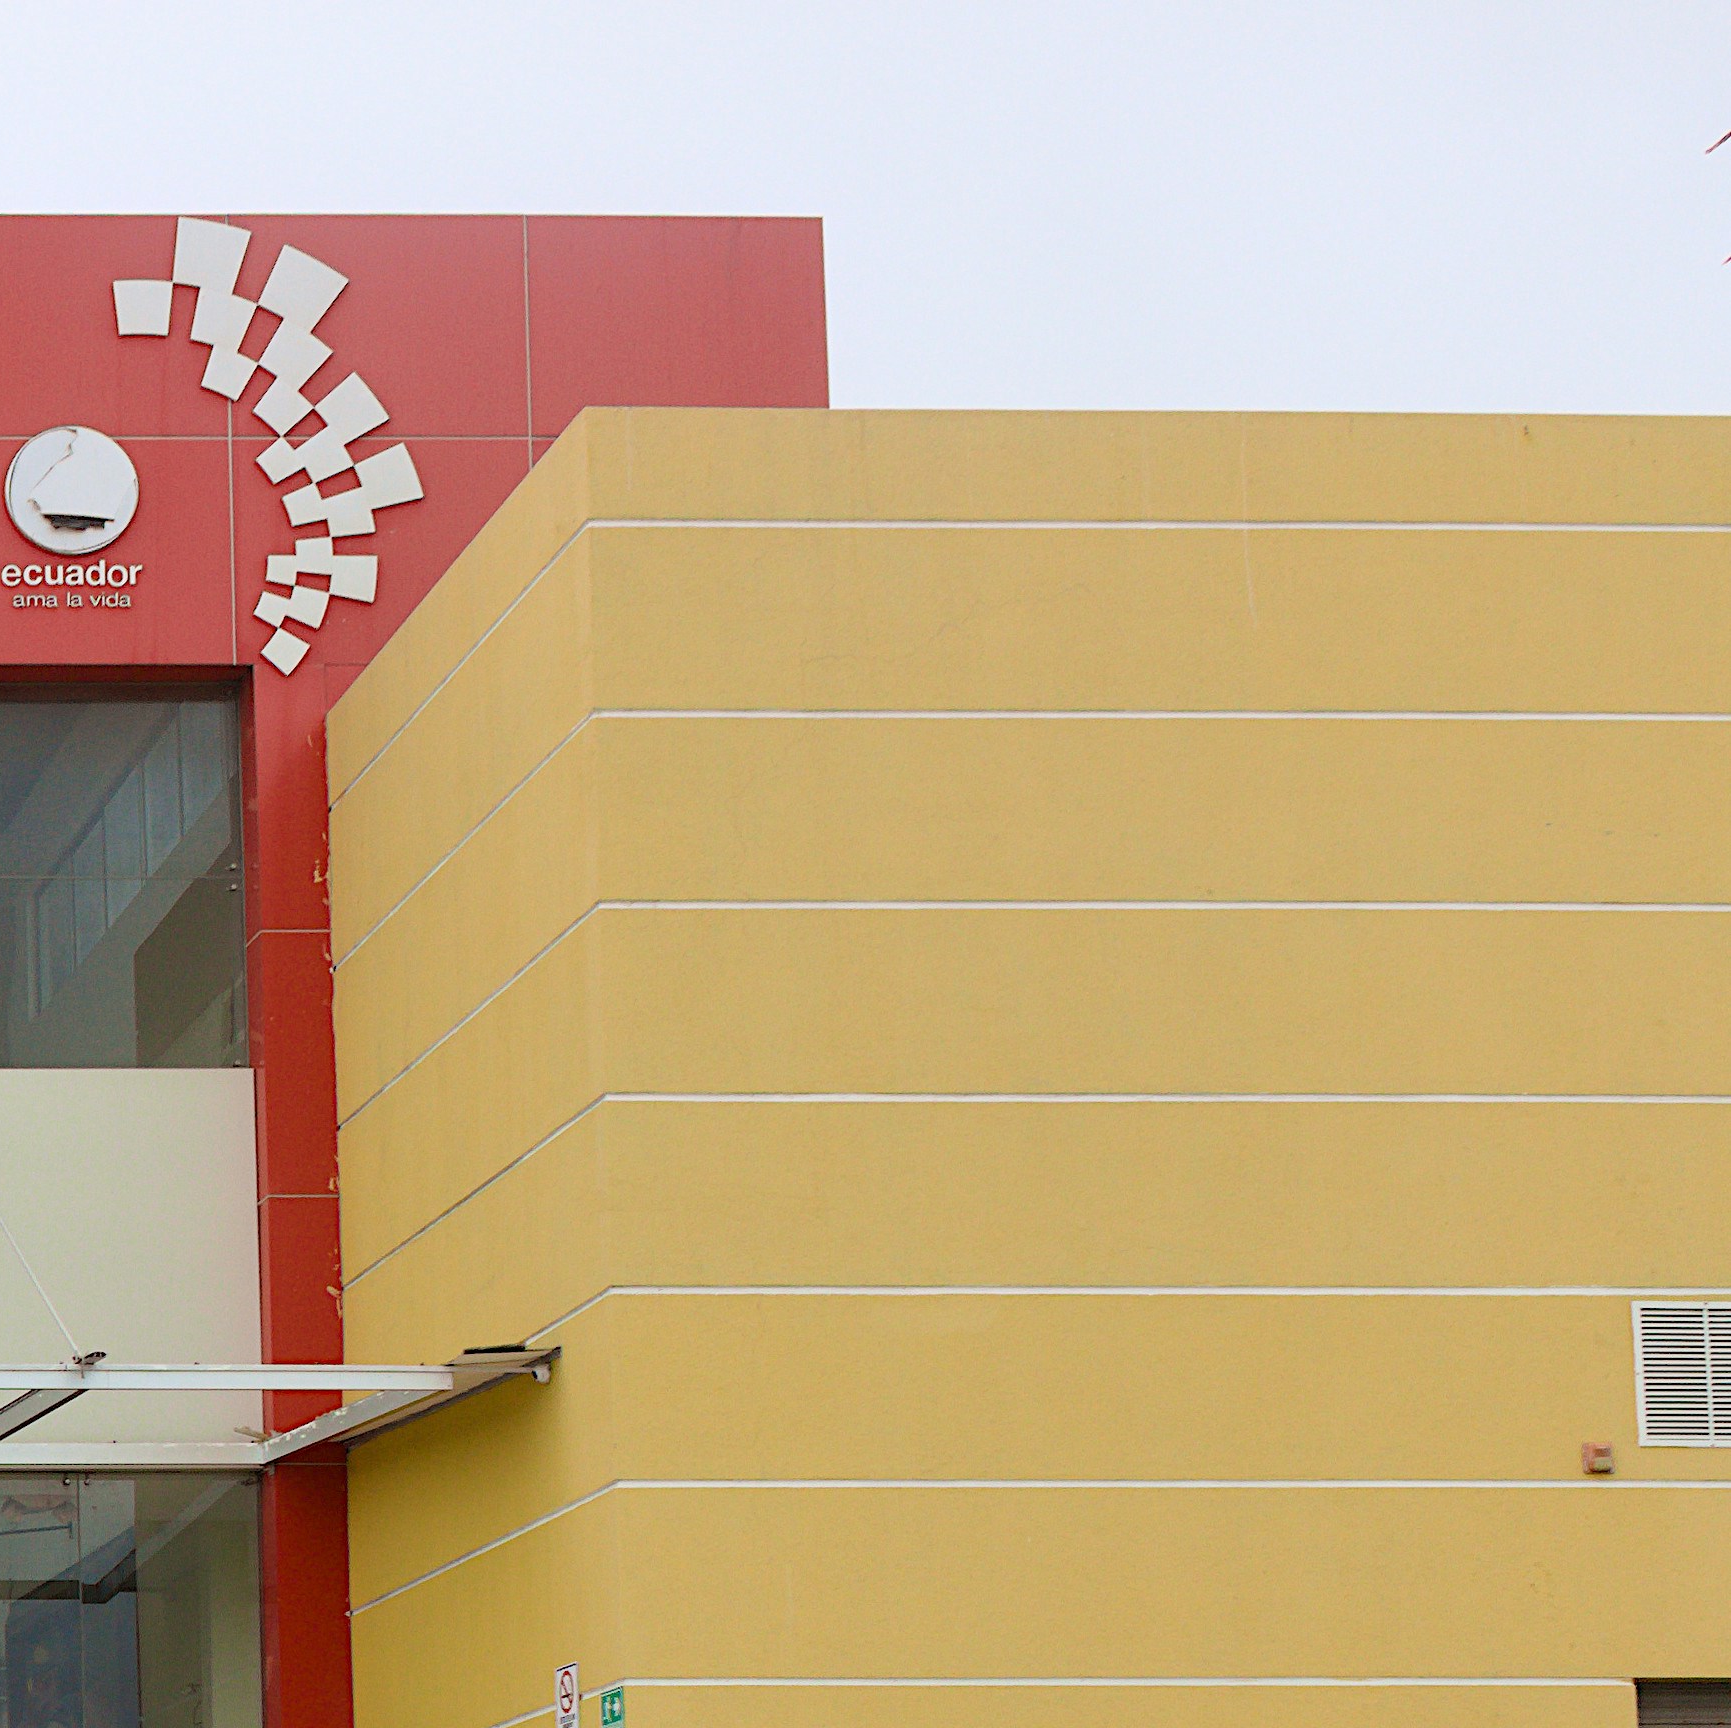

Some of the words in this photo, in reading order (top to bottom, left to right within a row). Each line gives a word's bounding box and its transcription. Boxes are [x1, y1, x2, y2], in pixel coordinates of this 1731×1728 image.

[0, 559, 144, 588] ecuador
[12, 593, 59, 608] ama
[66, 591, 84, 608] la
[90, 591, 132, 608] vida
